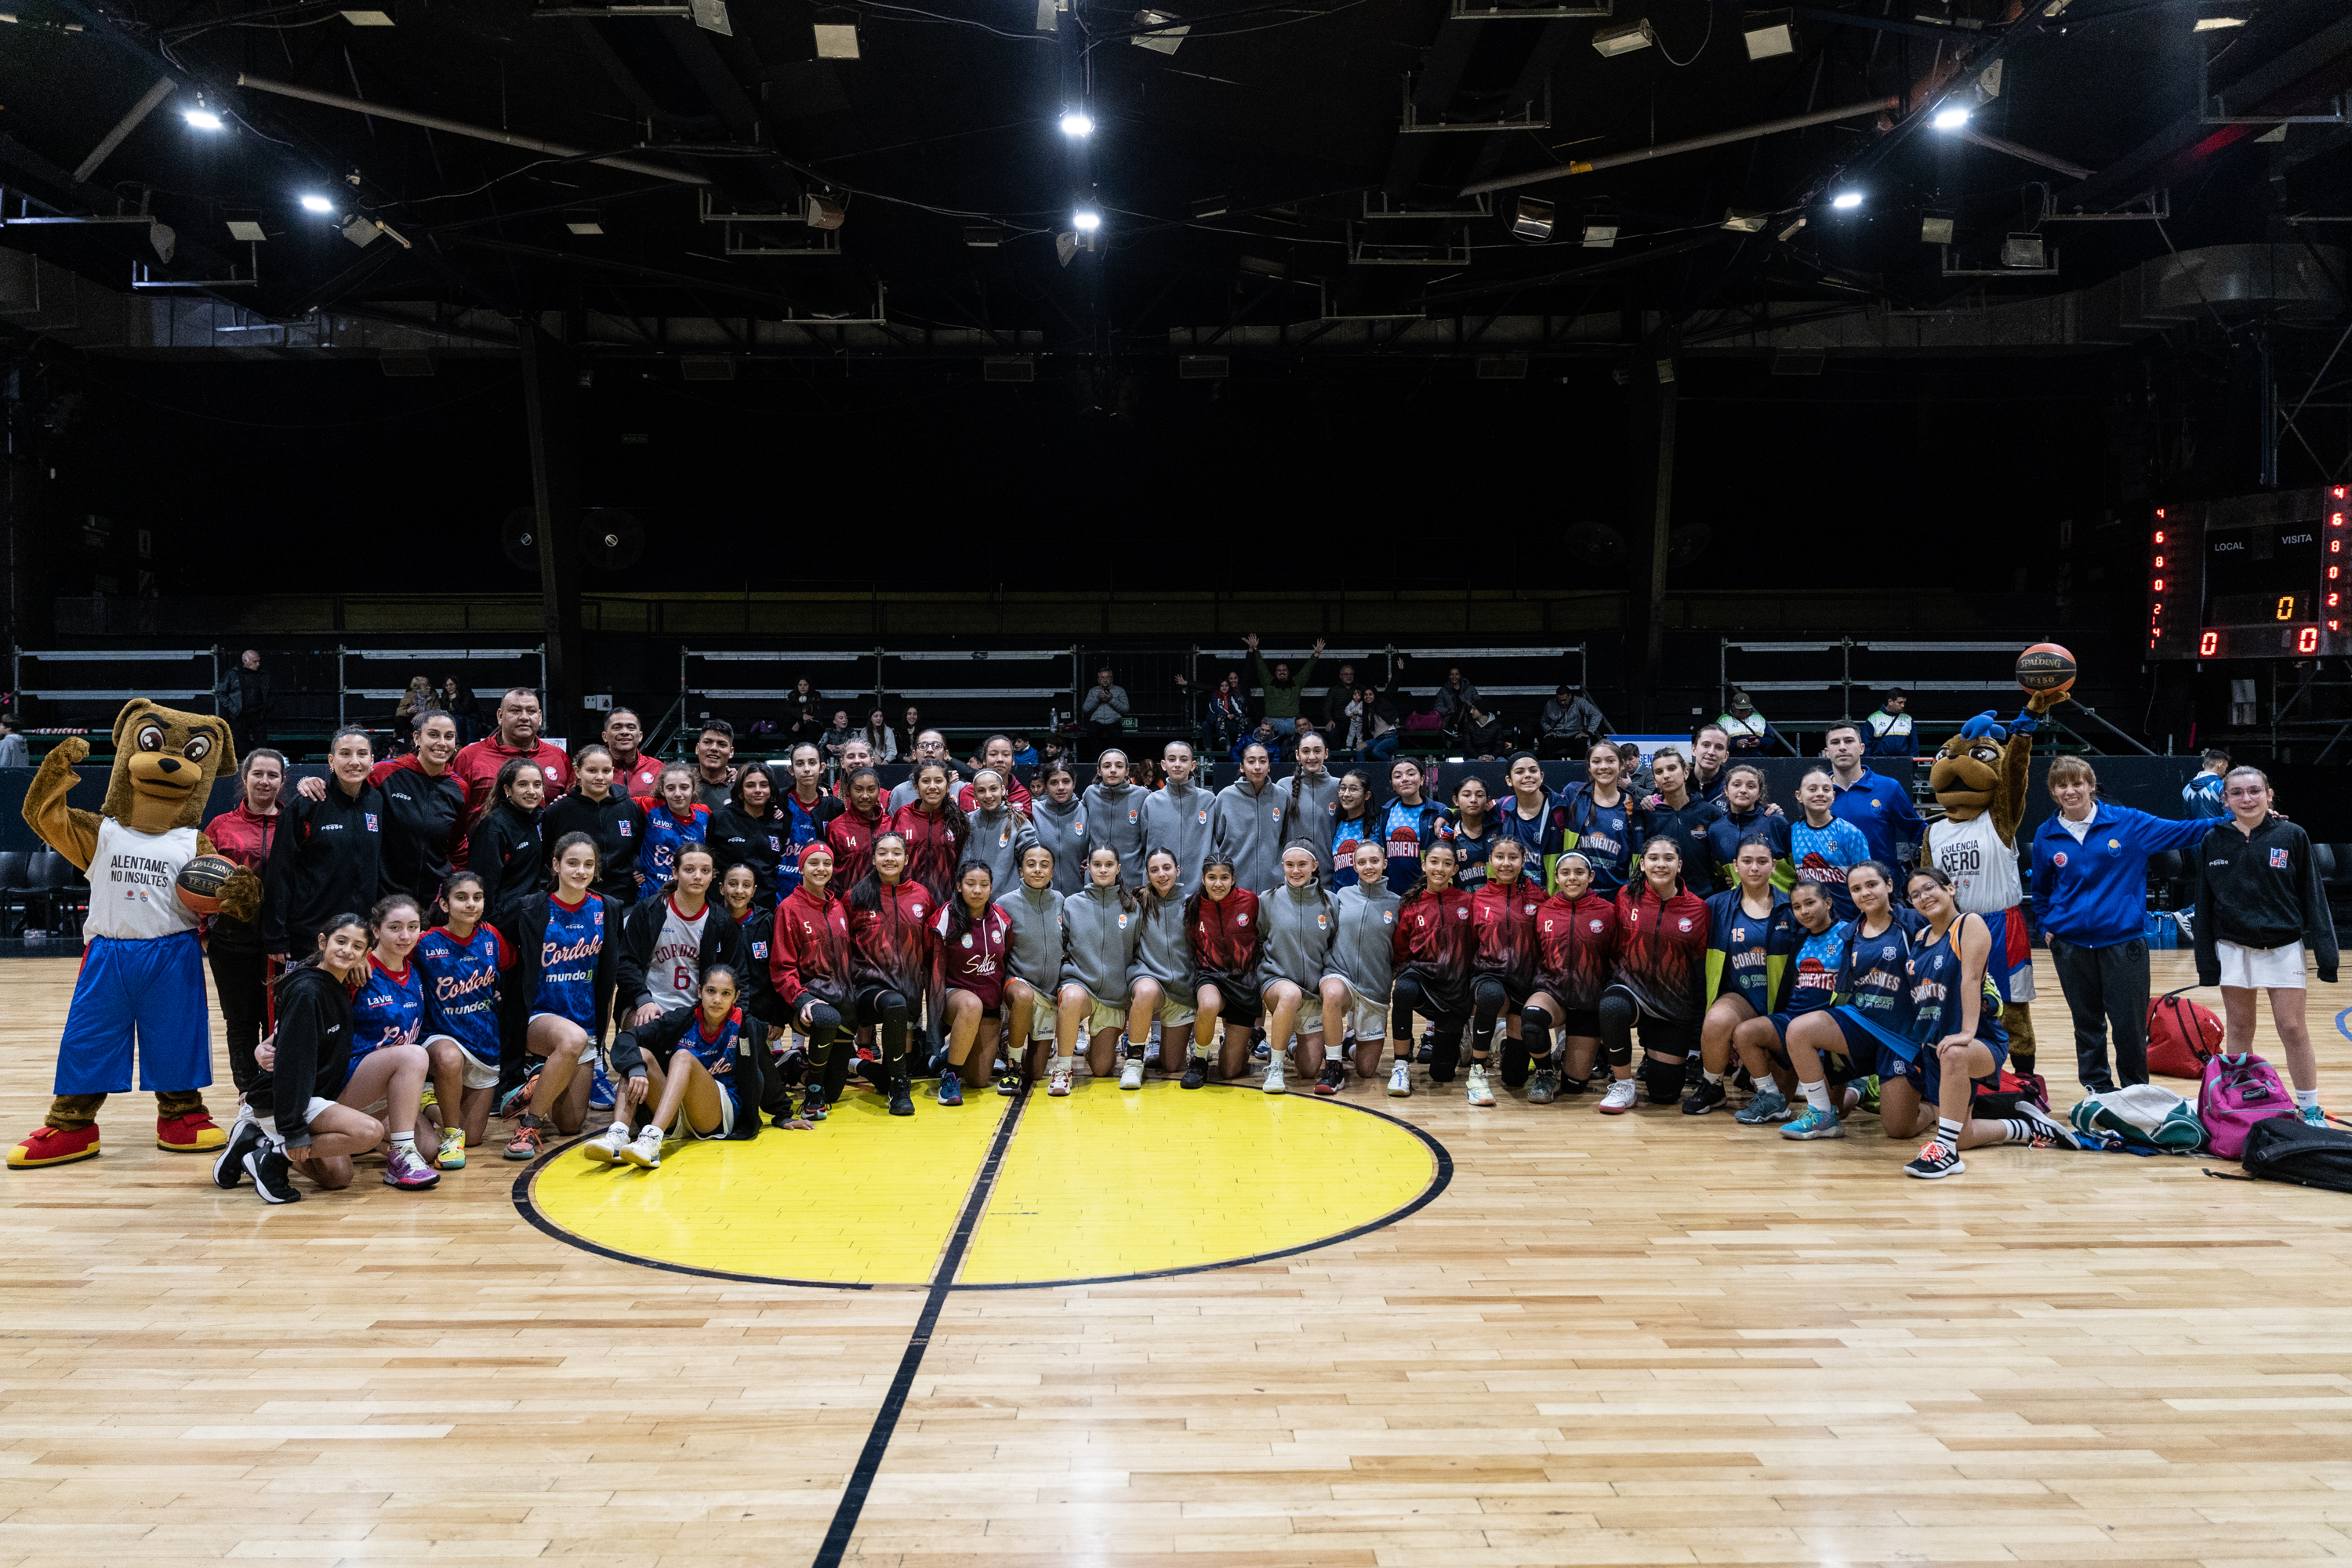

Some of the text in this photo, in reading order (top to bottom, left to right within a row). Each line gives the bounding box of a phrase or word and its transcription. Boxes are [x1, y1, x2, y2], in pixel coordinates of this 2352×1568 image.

[2332, 513, 2342, 526] 6
[2155, 532, 2164, 543] 6
[2214, 533, 2313, 552] LOCAL VISITA
[2331, 540, 2339, 553] 8
[2155, 556, 2164, 568] 8
[2328, 566, 2338, 579] 0
[2154, 579, 2164, 591] 0
[2328, 593, 2338, 606] 2
[2276, 596, 2294, 620] 0
[2327, 619, 2339, 631] 4
[2200, 632, 2218, 655] 0
[2299, 627, 2318, 652] 0
[2020, 659, 2061, 669] SPALDING
[906, 829, 913, 840] 11
[846, 836, 856, 848] 14
[1941, 840, 1979, 855] VIOLENCIA
[1457, 848, 1468, 862] 13
[1941, 849, 1980, 873] CERO
[189, 860, 234, 877] SPALDING
[111, 870, 169, 887] NO INSULTES
[1484, 907, 1490, 918] 7
[1631, 908, 1639, 921] 6
[804, 921, 813, 934] 5
[1199, 921, 1206, 933] 4
[1417, 915, 1425, 927] 8
[1544, 920, 1553, 932] 12
[1731, 927, 1745, 942] 15
[962, 953, 997, 974] Salta
[673, 966, 691, 990] 6
